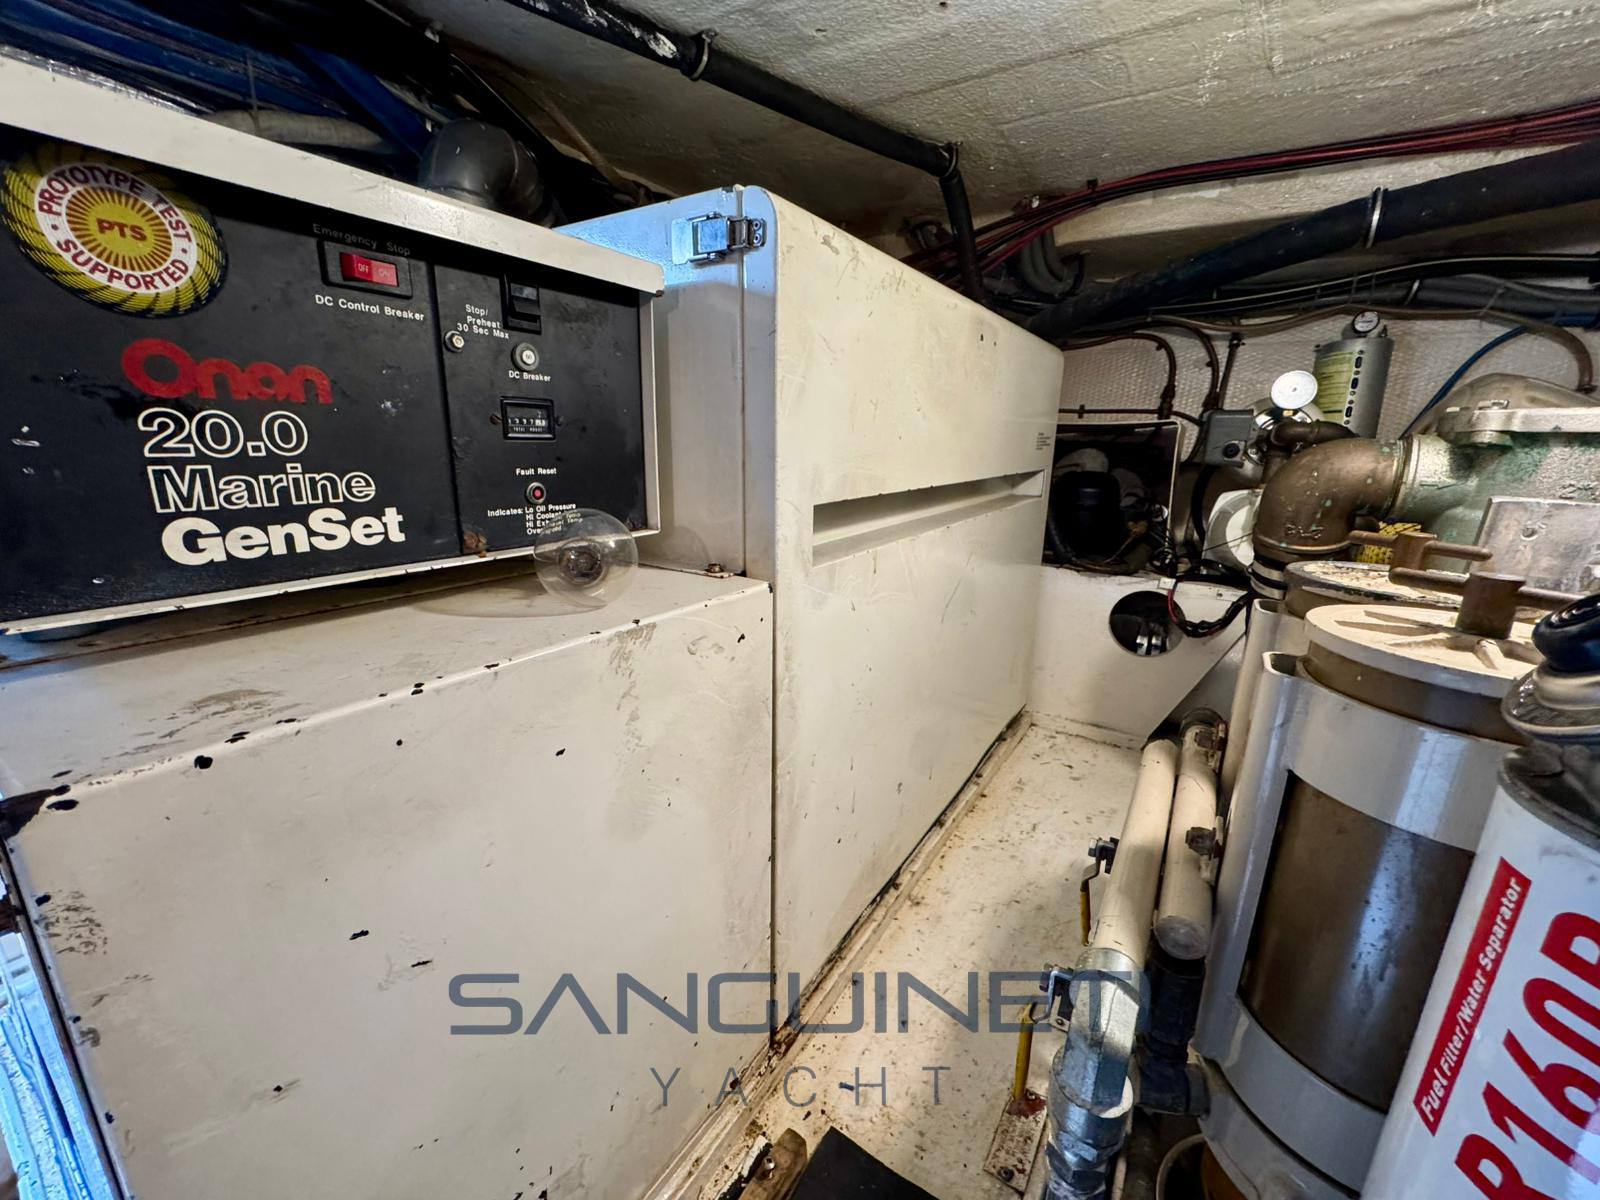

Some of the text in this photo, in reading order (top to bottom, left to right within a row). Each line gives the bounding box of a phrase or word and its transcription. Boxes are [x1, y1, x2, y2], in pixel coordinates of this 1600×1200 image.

[38, 166, 192, 243] PROTOTYPE TEST
[96, 217, 147, 242] PTS
[313, 223, 410, 256] Emergency Stop
[56, 238, 189, 290] SUPPORTED
[315, 294, 425, 321] DC Control Breaker
[467, 315, 500, 329] Preheat
[457, 322, 509, 339] 30 Sec Max
[121, 337, 333, 405] Onan
[508, 370, 551, 382] DC Breaker
[137, 407, 308, 458] 20.0
[147, 463, 376, 513] Marine
[516, 467, 557, 476] Fault Reset
[525, 506, 534, 514] Lo
[548, 503, 576, 511] Pressure
[161, 507, 406, 566] GenSet
[1420, 876, 1522, 1122] Fuel Filter/Water Separator
